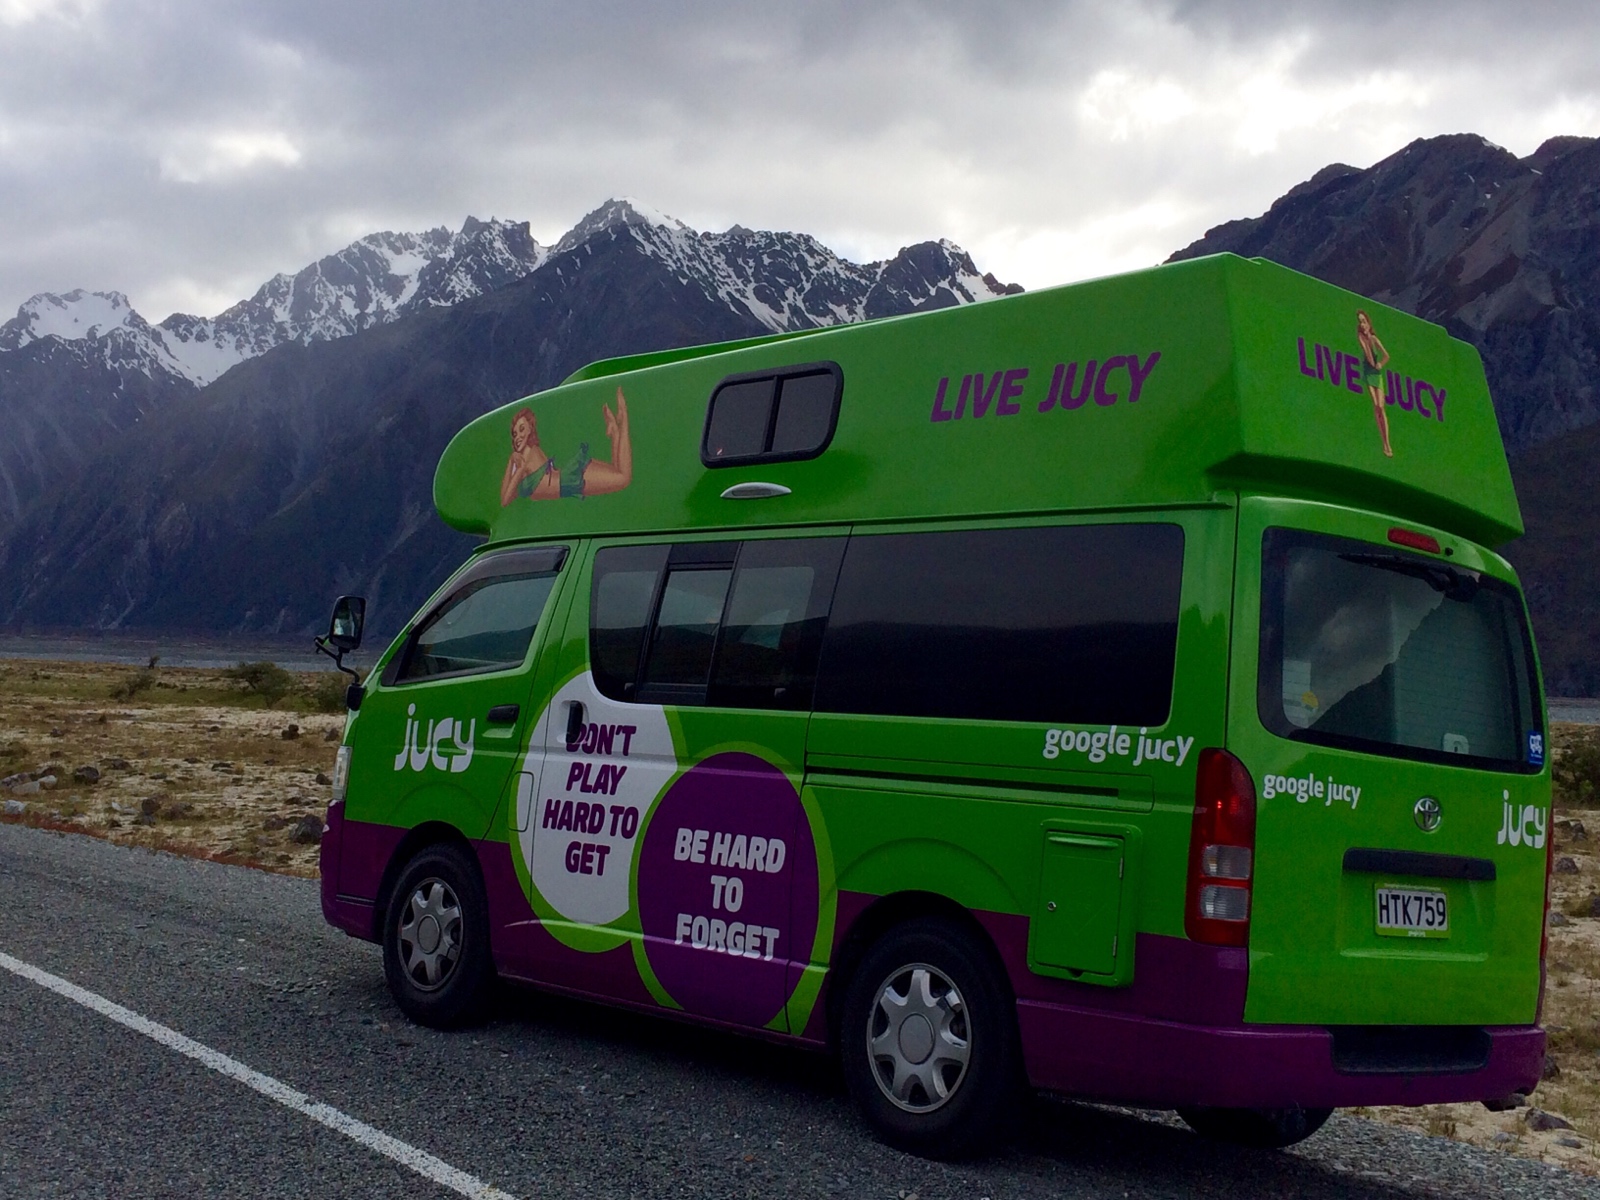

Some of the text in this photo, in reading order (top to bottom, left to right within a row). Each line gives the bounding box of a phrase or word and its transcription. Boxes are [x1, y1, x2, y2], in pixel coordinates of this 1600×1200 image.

[930, 351, 1161, 422] LIVE JUCY
[1298, 337, 1446, 422] LIVE JUCY
[394, 703, 475, 773] jucy
[1043, 725, 1194, 766] google jucy
[566, 762, 627, 795] PLAY
[1263, 773, 1361, 809] google jucy
[543, 799, 639, 839] HARD TO
[1497, 789, 1546, 849] jucy
[565, 841, 610, 876] GET
[673, 827, 786, 874] BE HARD
[710, 874, 744, 913] TO
[1379, 893, 1446, 927] HTK759
[674, 913, 780, 961] FORGET
